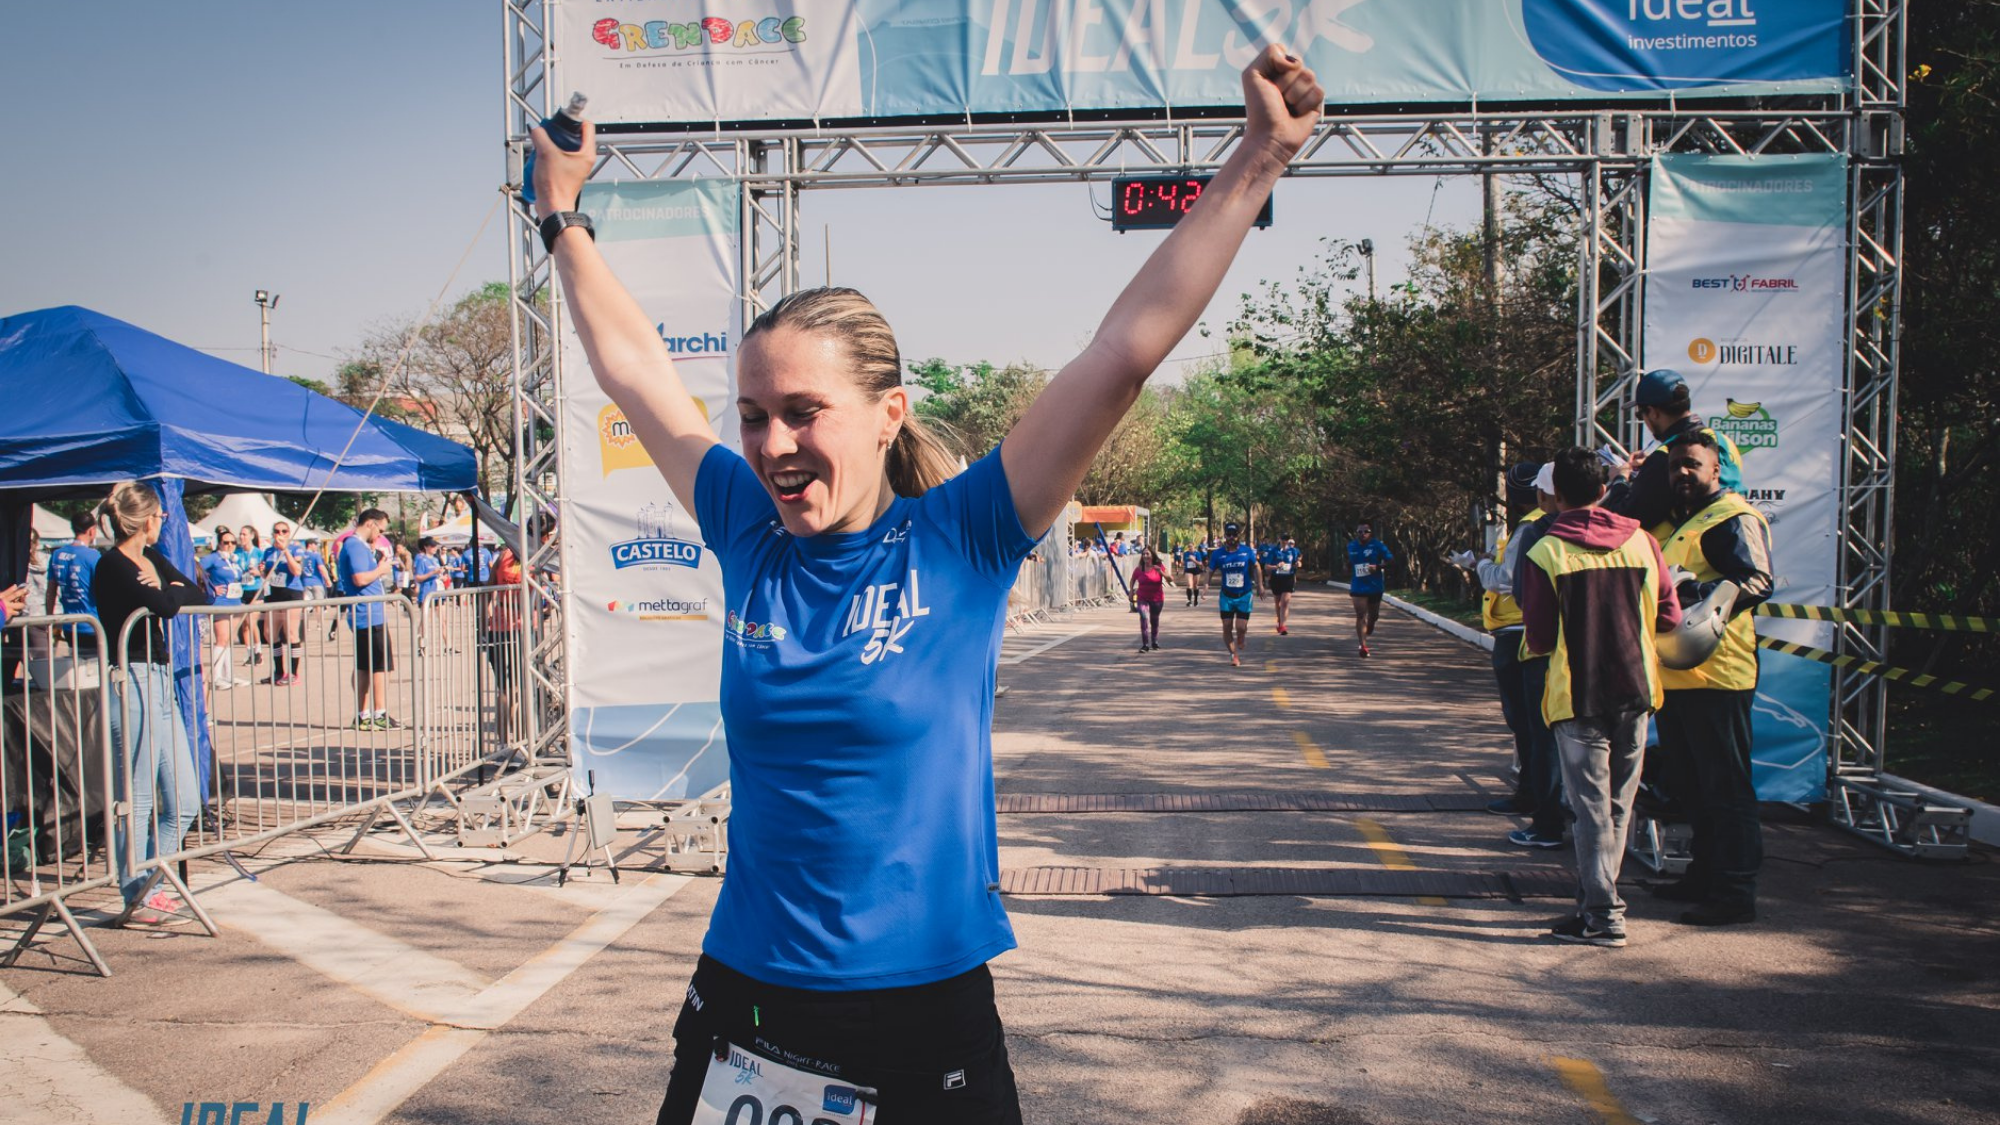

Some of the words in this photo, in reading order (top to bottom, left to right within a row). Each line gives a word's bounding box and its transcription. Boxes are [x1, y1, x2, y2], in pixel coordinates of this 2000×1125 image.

[592, 16, 807, 51] GRENDACC
[981, 0, 1220, 75] IDEAL
[1628, 33, 1757, 50] investimentos
[1679, 179, 1814, 193] PATROCINADORES
[1692, 279, 1730, 288] BEST
[1751, 279, 1799, 288] FABRIL
[1720, 345, 1798, 365] DIGITALE
[1711, 418, 1775, 430] Bananas
[1744, 489, 1786, 500] AHY
[616, 543, 697, 561] CASTELO
[639, 598, 708, 614] mettagraf
[842, 569, 930, 638] IDEAL
[861, 615, 915, 665] 5K
[755, 1036, 781, 1055] FILA
[729, 1050, 763, 1078] IDEAL
[827, 1092, 853, 1105] ideal
